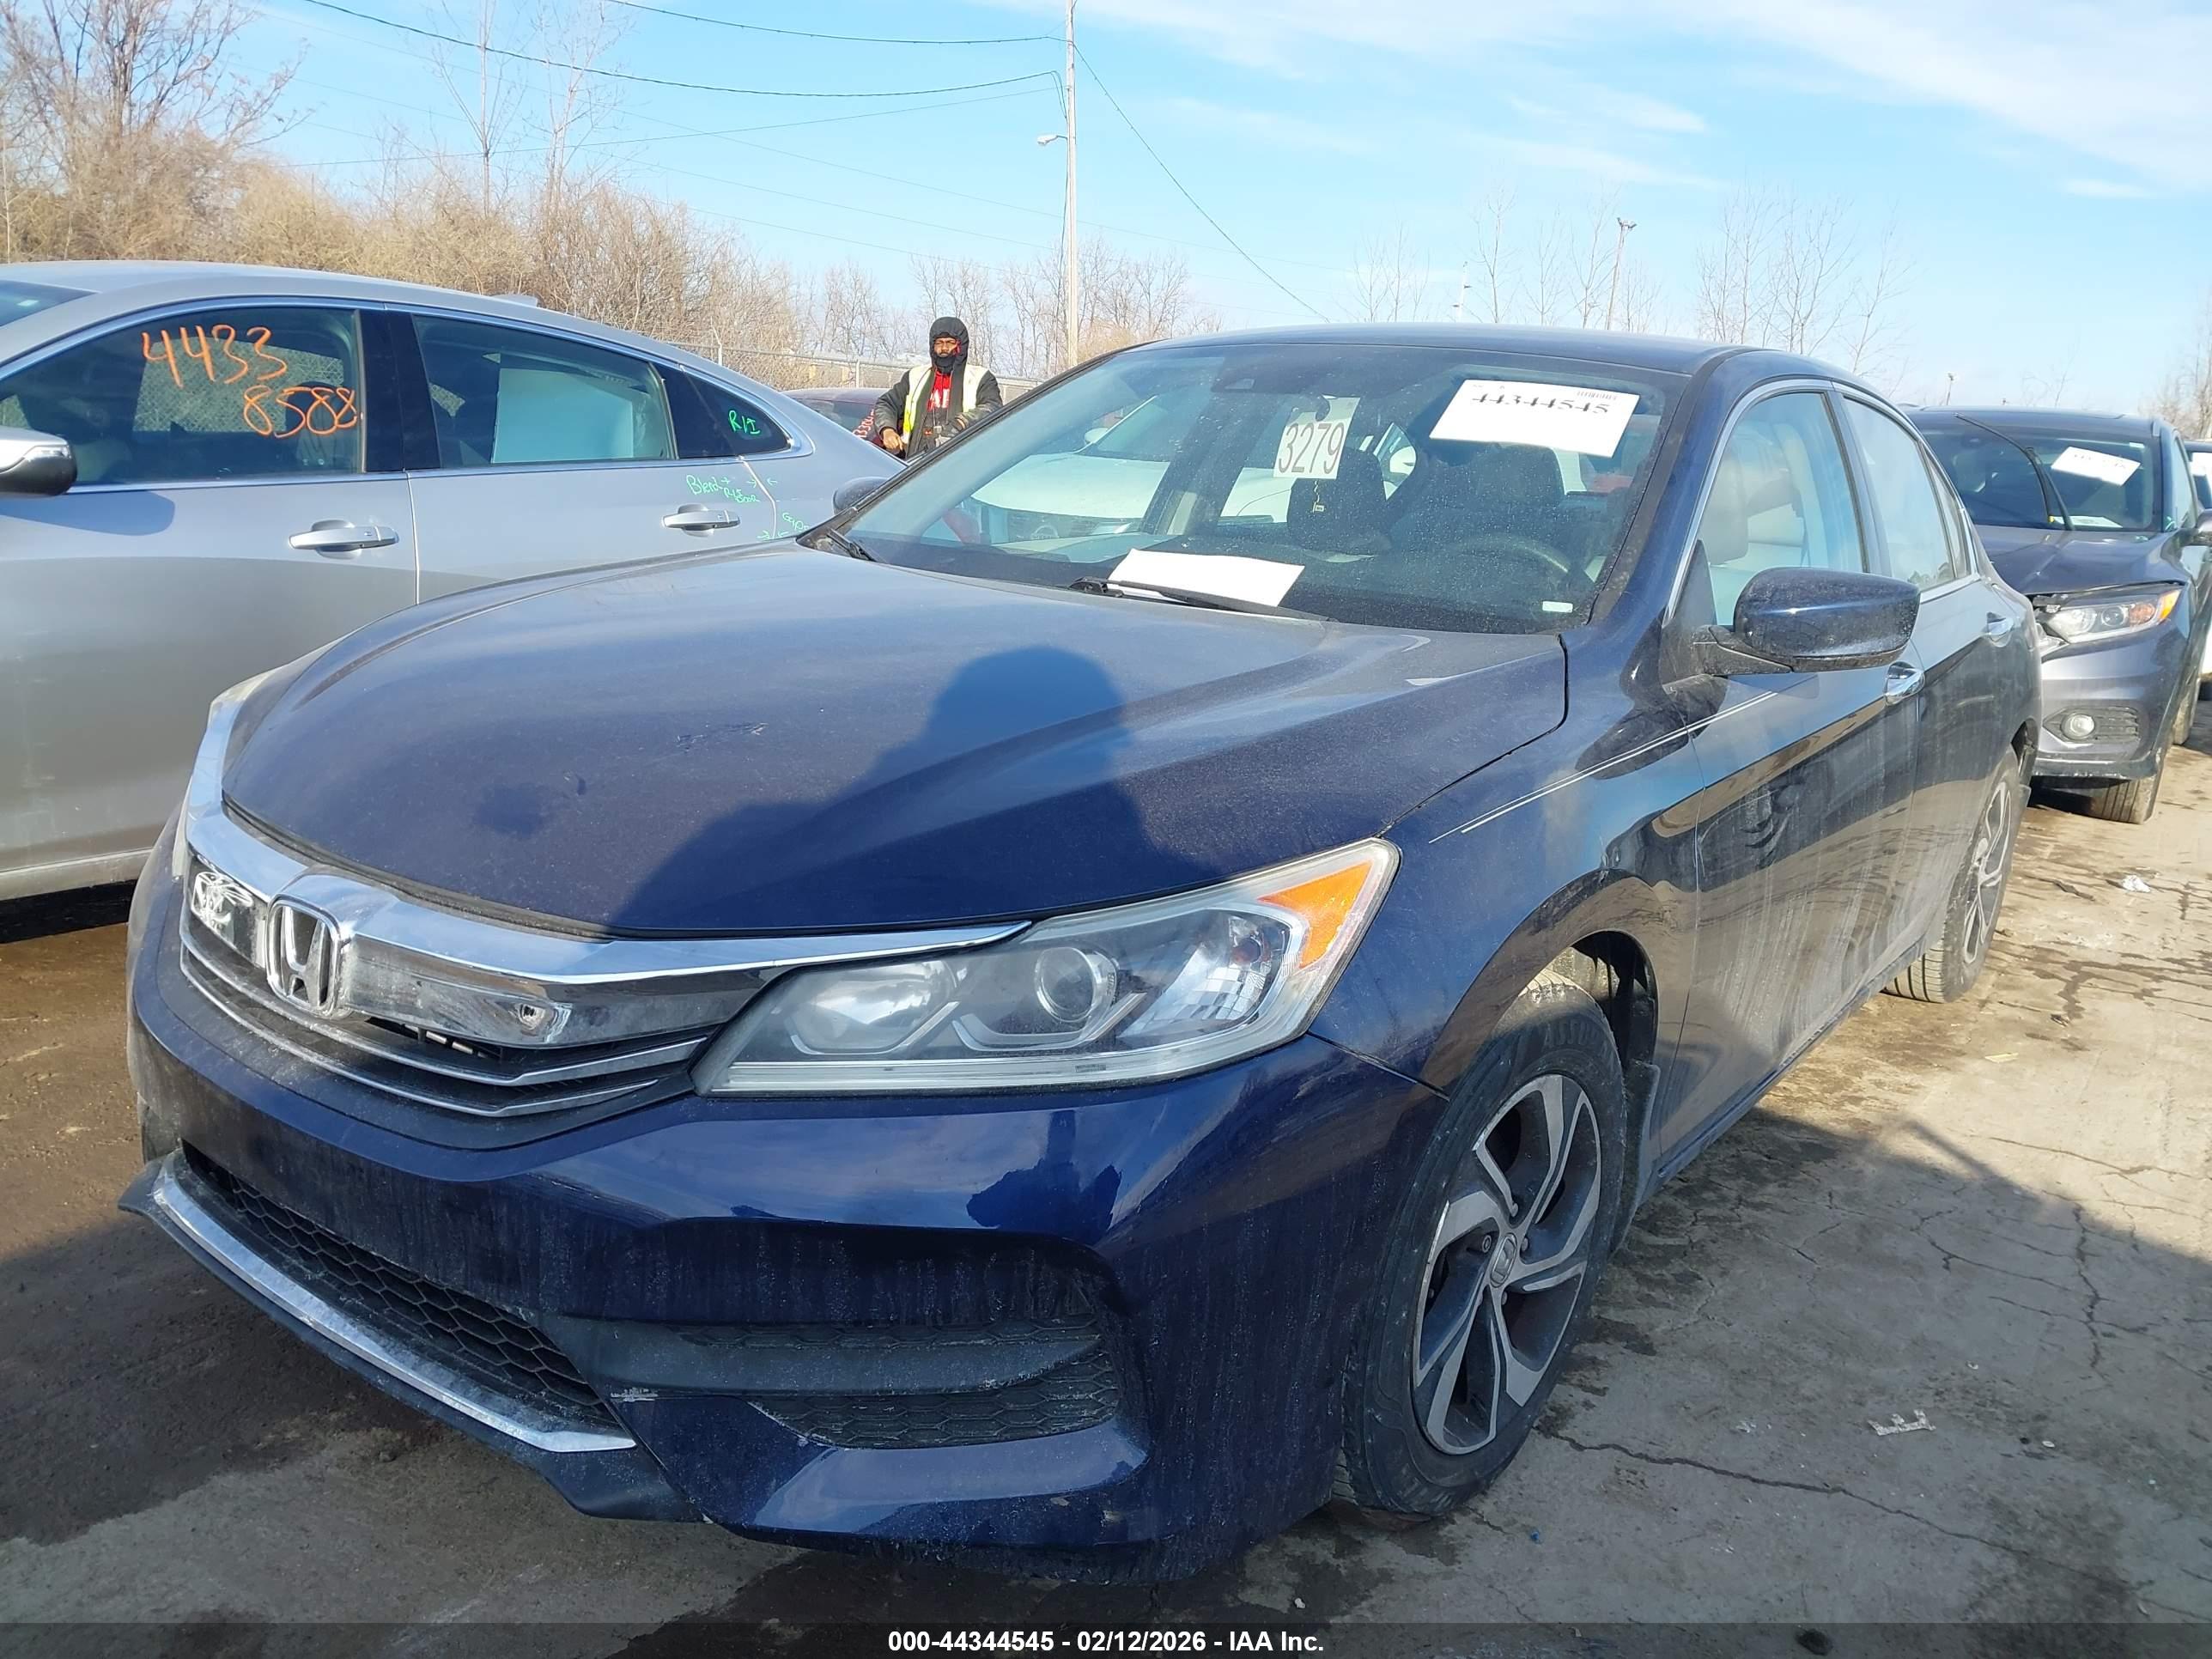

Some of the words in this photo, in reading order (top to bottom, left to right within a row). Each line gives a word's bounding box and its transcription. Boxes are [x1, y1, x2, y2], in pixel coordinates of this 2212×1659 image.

[141, 324, 288, 388] 4433
[243, 384, 358, 439] 8588
[1278, 422, 1345, 474] 3279
